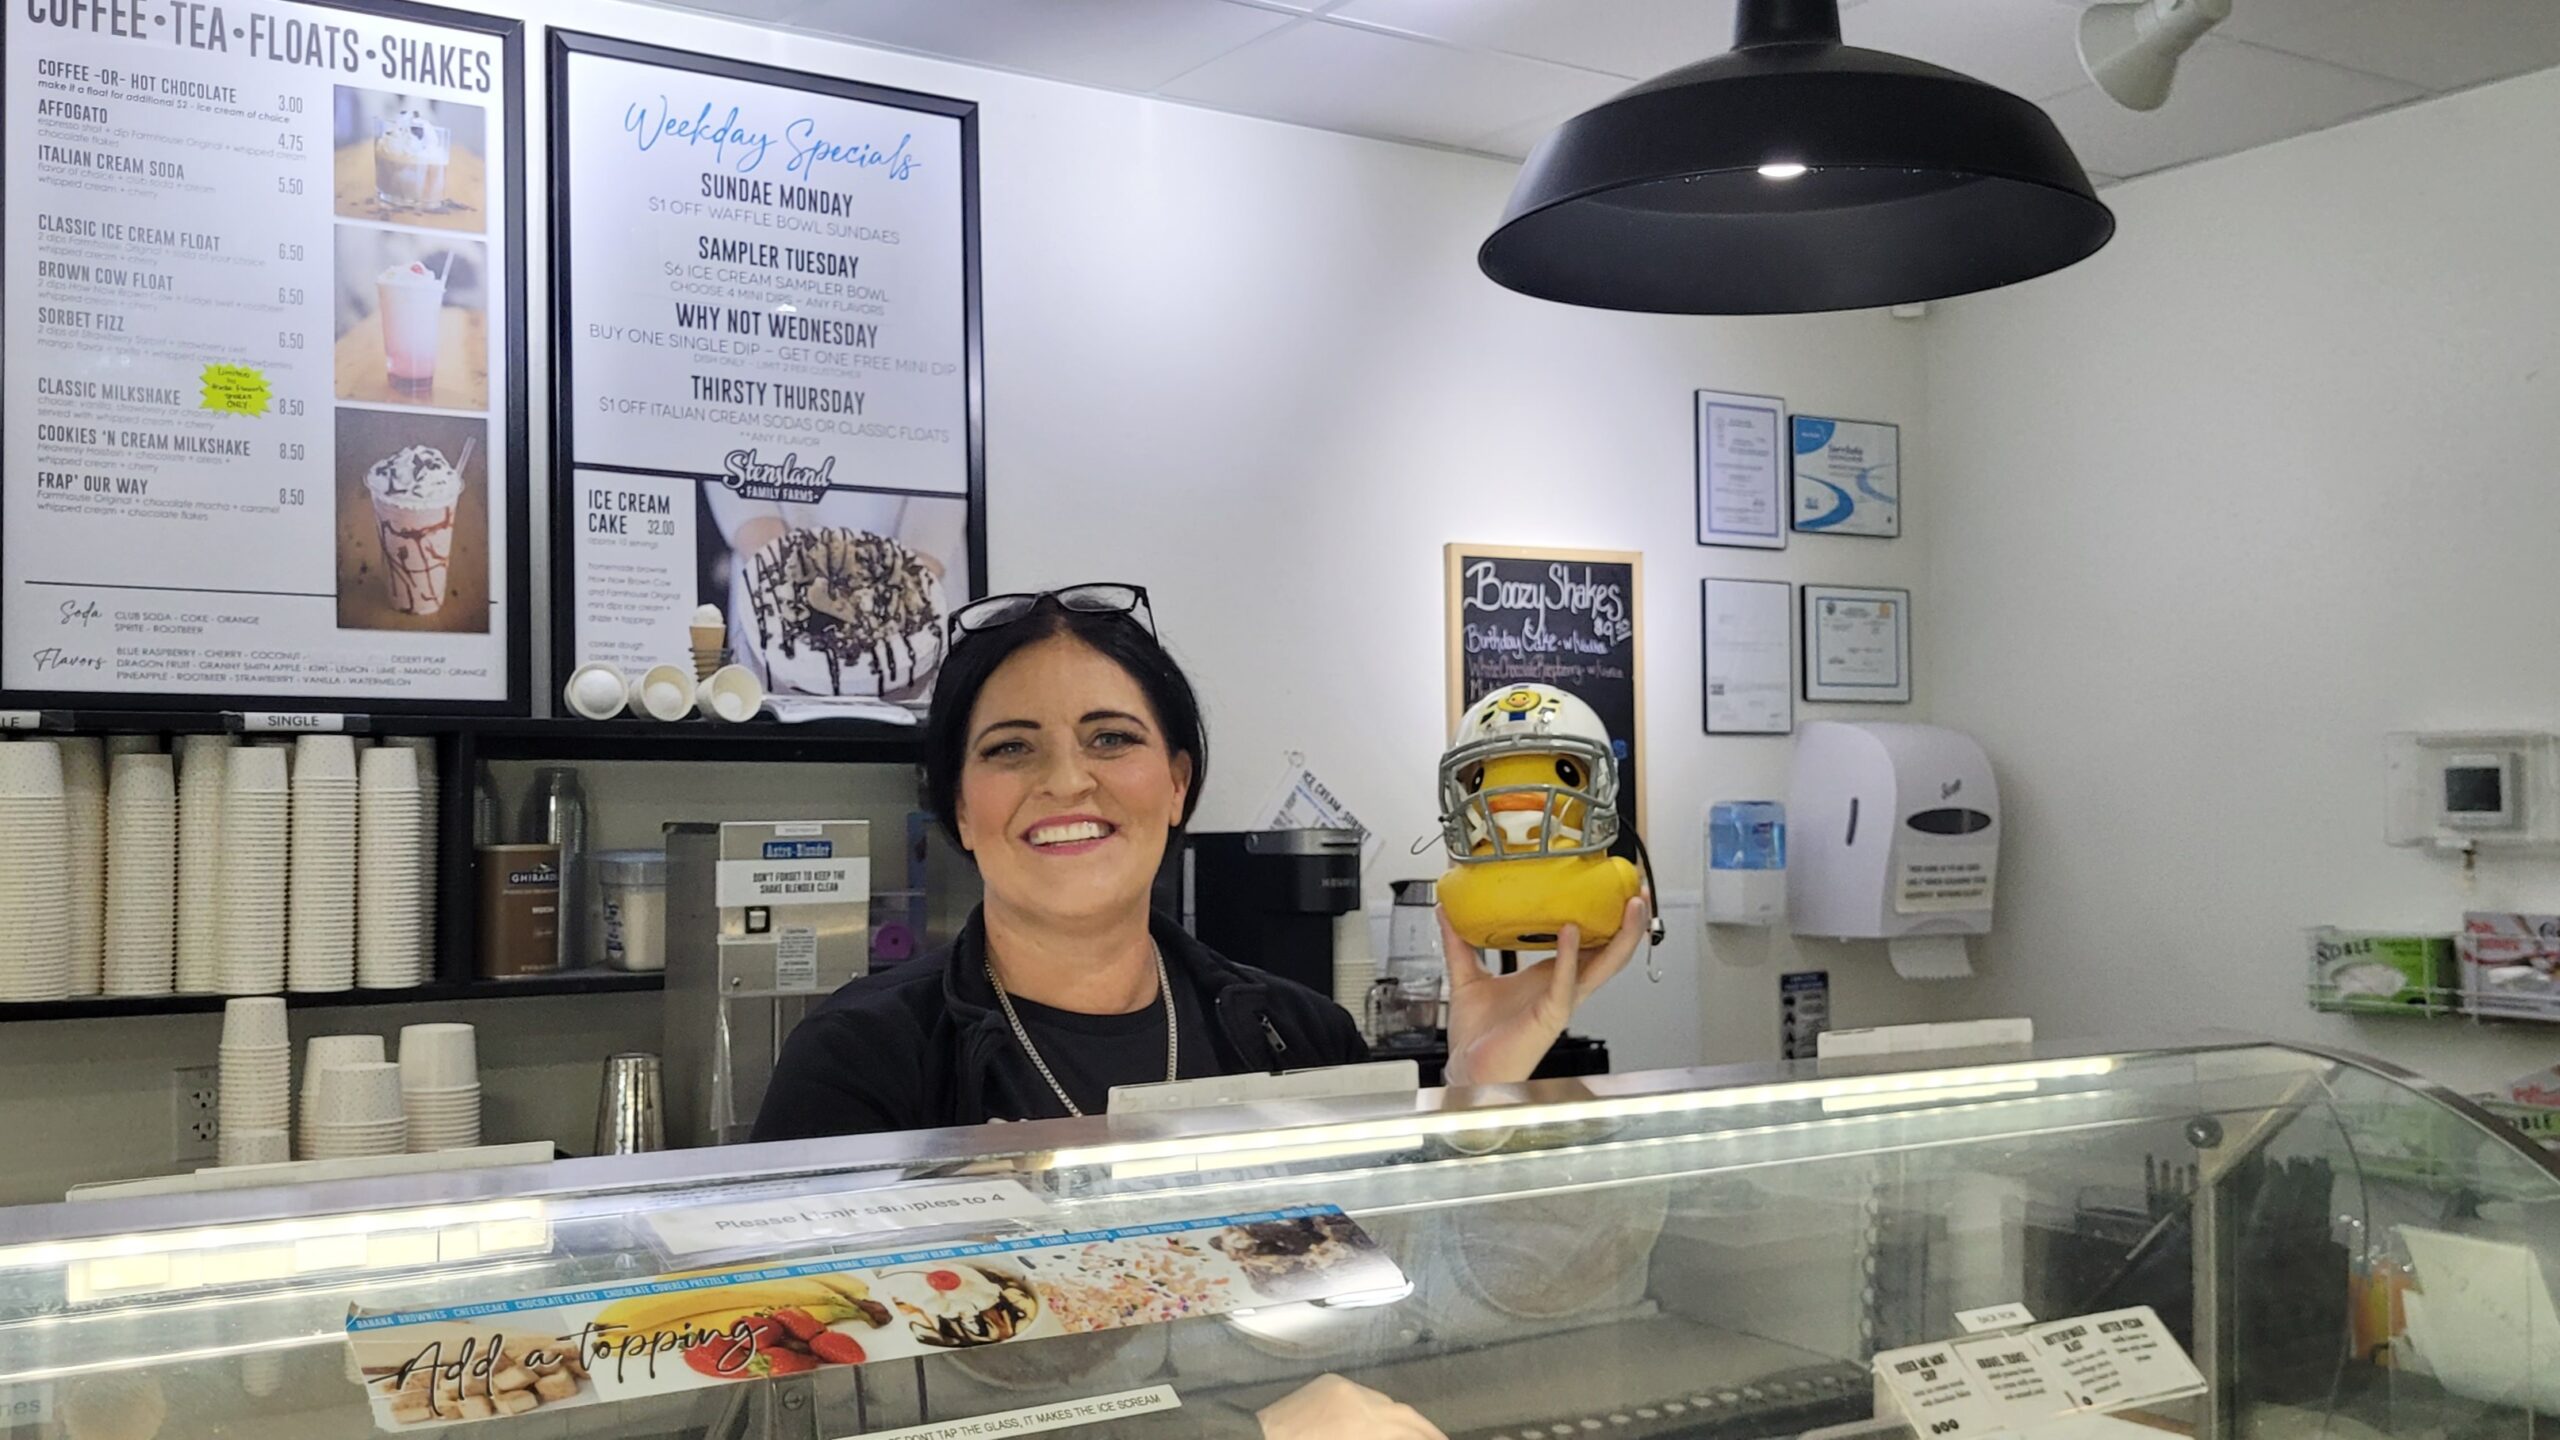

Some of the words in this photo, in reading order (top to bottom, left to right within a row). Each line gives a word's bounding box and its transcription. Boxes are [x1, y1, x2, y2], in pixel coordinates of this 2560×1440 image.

[171, 1, 227, 52] TEA
[251, 13, 358, 72] FLOATS
[382, 35, 490, 93] SHAKES
[38, 80, 66, 91] make
[69, 84, 76, 93] it
[87, 87, 108, 98] float
[111, 90, 123, 100] for
[126, 91, 174, 107] additional
[197, 103, 211, 112] ice
[214, 106, 244, 117] cream
[247, 110, 256, 118] of
[259, 110, 290, 123] choice
[39, 59, 89, 81] COFFEE
[93, 70, 126, 86] -OR-
[131, 73, 156, 92] HOT
[161, 78, 236, 104] CHOCOLATE
[278, 95, 303, 113] 3.00
[38, 99, 108, 123] AFFOGATO
[278, 133, 303, 152] 4.75
[625, 94, 778, 173] Weekday
[785, 118, 921, 181] Specials
[39, 144, 91, 168] ITALIAN
[97, 153, 144, 174] CREAM
[150, 160, 184, 180] SODA
[278, 177, 303, 195] 5.50
[701, 173, 773, 206] SUNDAE
[779, 184, 853, 218] MONDAY
[38, 214, 96, 236] CLASSIC
[102, 224, 123, 240] ICE
[128, 226, 175, 246] CREAM
[180, 233, 220, 251] FLOAT
[279, 243, 303, 261] 6.50
[649, 197, 666, 212] $1
[670, 200, 702, 216] OFF
[708, 204, 772, 227] WAFFLE
[777, 214, 822, 236] BOWL
[826, 221, 900, 244] SUNDAES
[699, 236, 779, 269] SAMPLER
[785, 248, 859, 279] TUESDAY
[38, 260, 90, 282] BROWN
[95, 268, 127, 285] COW
[133, 273, 173, 291] FLOAT
[279, 287, 303, 305] 6.50
[664, 261, 684, 277] $6
[688, 264, 713, 280] ICE
[717, 268, 772, 287] CREAM
[775, 276, 843, 296] SAMPLER
[847, 284, 889, 302] BOWL
[670, 280, 725, 298] CHOOSE
[727, 286, 735, 298] 4
[738, 288, 764, 301] MINI
[805, 297, 830, 308] ANY
[832, 299, 885, 316] FLAVORS
[38, 307, 92, 328] SORBET
[97, 314, 125, 332] FIZZ
[279, 332, 303, 349] 6.50
[676, 302, 720, 331] WHY
[727, 310, 761, 336] NOT
[768, 312, 878, 349] WEDNESDAY
[590, 324, 625, 341] BUY
[628, 329, 664, 346] ONE
[669, 334, 728, 354] SINGLE
[733, 341, 760, 356] DIP
[778, 345, 810, 362] GET
[814, 350, 849, 367] ONE
[853, 354, 891, 371] FREE
[895, 358, 928, 374] MINI
[932, 361, 957, 376] DIP
[38, 377, 96, 398] CLASSIC
[102, 383, 180, 406] MILKSHAKE
[280, 399, 304, 416] 8.50
[691, 375, 767, 405] THIRSTY
[774, 383, 865, 416] THURSDAY
[600, 397, 617, 411] $1
[619, 399, 647, 415] OFF
[651, 402, 705, 421] ITALIAN
[709, 407, 760, 426] CREAM
[763, 413, 812, 431] SODAS
[815, 417, 836, 433] OR
[839, 420, 896, 439] CLASSIC
[900, 425, 949, 444] FLOATS
[777, 433, 820, 446] FLAVOR
[38, 424, 97, 445] COOKIES
[121, 432, 168, 450] CREAM
[174, 437, 250, 456] MILKSHAKE
[280, 444, 304, 461] 8.50
[38, 472, 78, 490] FRAP'
[84, 475, 110, 492] OUR
[116, 478, 148, 495] WAY
[280, 488, 304, 505] 8.50
[722, 448, 836, 491] Stensland
[588, 489, 612, 510] ICE
[619, 491, 670, 514] CREAM
[746, 486, 780, 500] FAMILY
[782, 488, 815, 503] FARMS
[589, 513, 627, 534] CAKE
[648, 520, 674, 535] 32.00
[60, 600, 102, 627] Soda
[115, 611, 140, 621] CLUB
[143, 612, 171, 621] SODA
[180, 614, 208, 623] COKE
[217, 616, 259, 625] ORANGE
[1464, 561, 1545, 640] Boozy
[1545, 563, 1624, 622] Shakes
[115, 624, 144, 632] SPRITE
[153, 625, 203, 634] ROOTBEER
[33, 648, 107, 671] Flavors
[116, 647, 138, 655] BLUE
[142, 648, 195, 657] RASPBERRY
[204, 650, 241, 659] CHERRY
[116, 659, 163, 668] DRAGON
[166, 660, 190, 669] FRUIT
[273, 664, 300, 672] APPLE
[448, 669, 487, 677] ORANGE
[116, 672, 167, 681] PINEAPPLE
[177, 672, 226, 681] ROOTBEER
[267, 715, 319, 727] SINGLE
[753, 872, 773, 882] DON'T
[776, 872, 801, 881] FORGET
[804, 871, 812, 880] TO
[815, 871, 831, 880] KEEP
[834, 870, 845, 880] THE
[760, 884, 782, 893] SHAKE
[785, 883, 814, 893] BLENDER
[817, 882, 838, 892] CLEAN
[715, 1215, 797, 1231] Please
[963, 1196, 986, 1207] to
[991, 1193, 1006, 1202] 4
[356, 1317, 394, 1329] BANANA
[398, 1310, 447, 1324] BROWNIES
[453, 1301, 509, 1317] CHEESECAKE
[516, 1295, 565, 1310] CHOCOLATE
[565, 1291, 597, 1304] FLAKES
[605, 1284, 651, 1299] CHOCOLATE
[653, 1280, 688, 1293] COVERED
[689, 1275, 727, 1288] PRETZELS
[368, 1333, 503, 1417] Add
[524, 1347, 564, 1372] a
[556, 1319, 768, 1384] topping
[936, 1428, 957, 1440] TAP
[960, 1425, 983, 1437] THE
[983, 1418, 1024, 1433] GLASS,
[1024, 1414, 1037, 1426] IT
[1036, 1409, 1073, 1424] MAKES
[1074, 1405, 1096, 1418] THE
[1097, 1401, 1114, 1413] ICE
[1117, 1394, 1161, 1410] SCREAM
